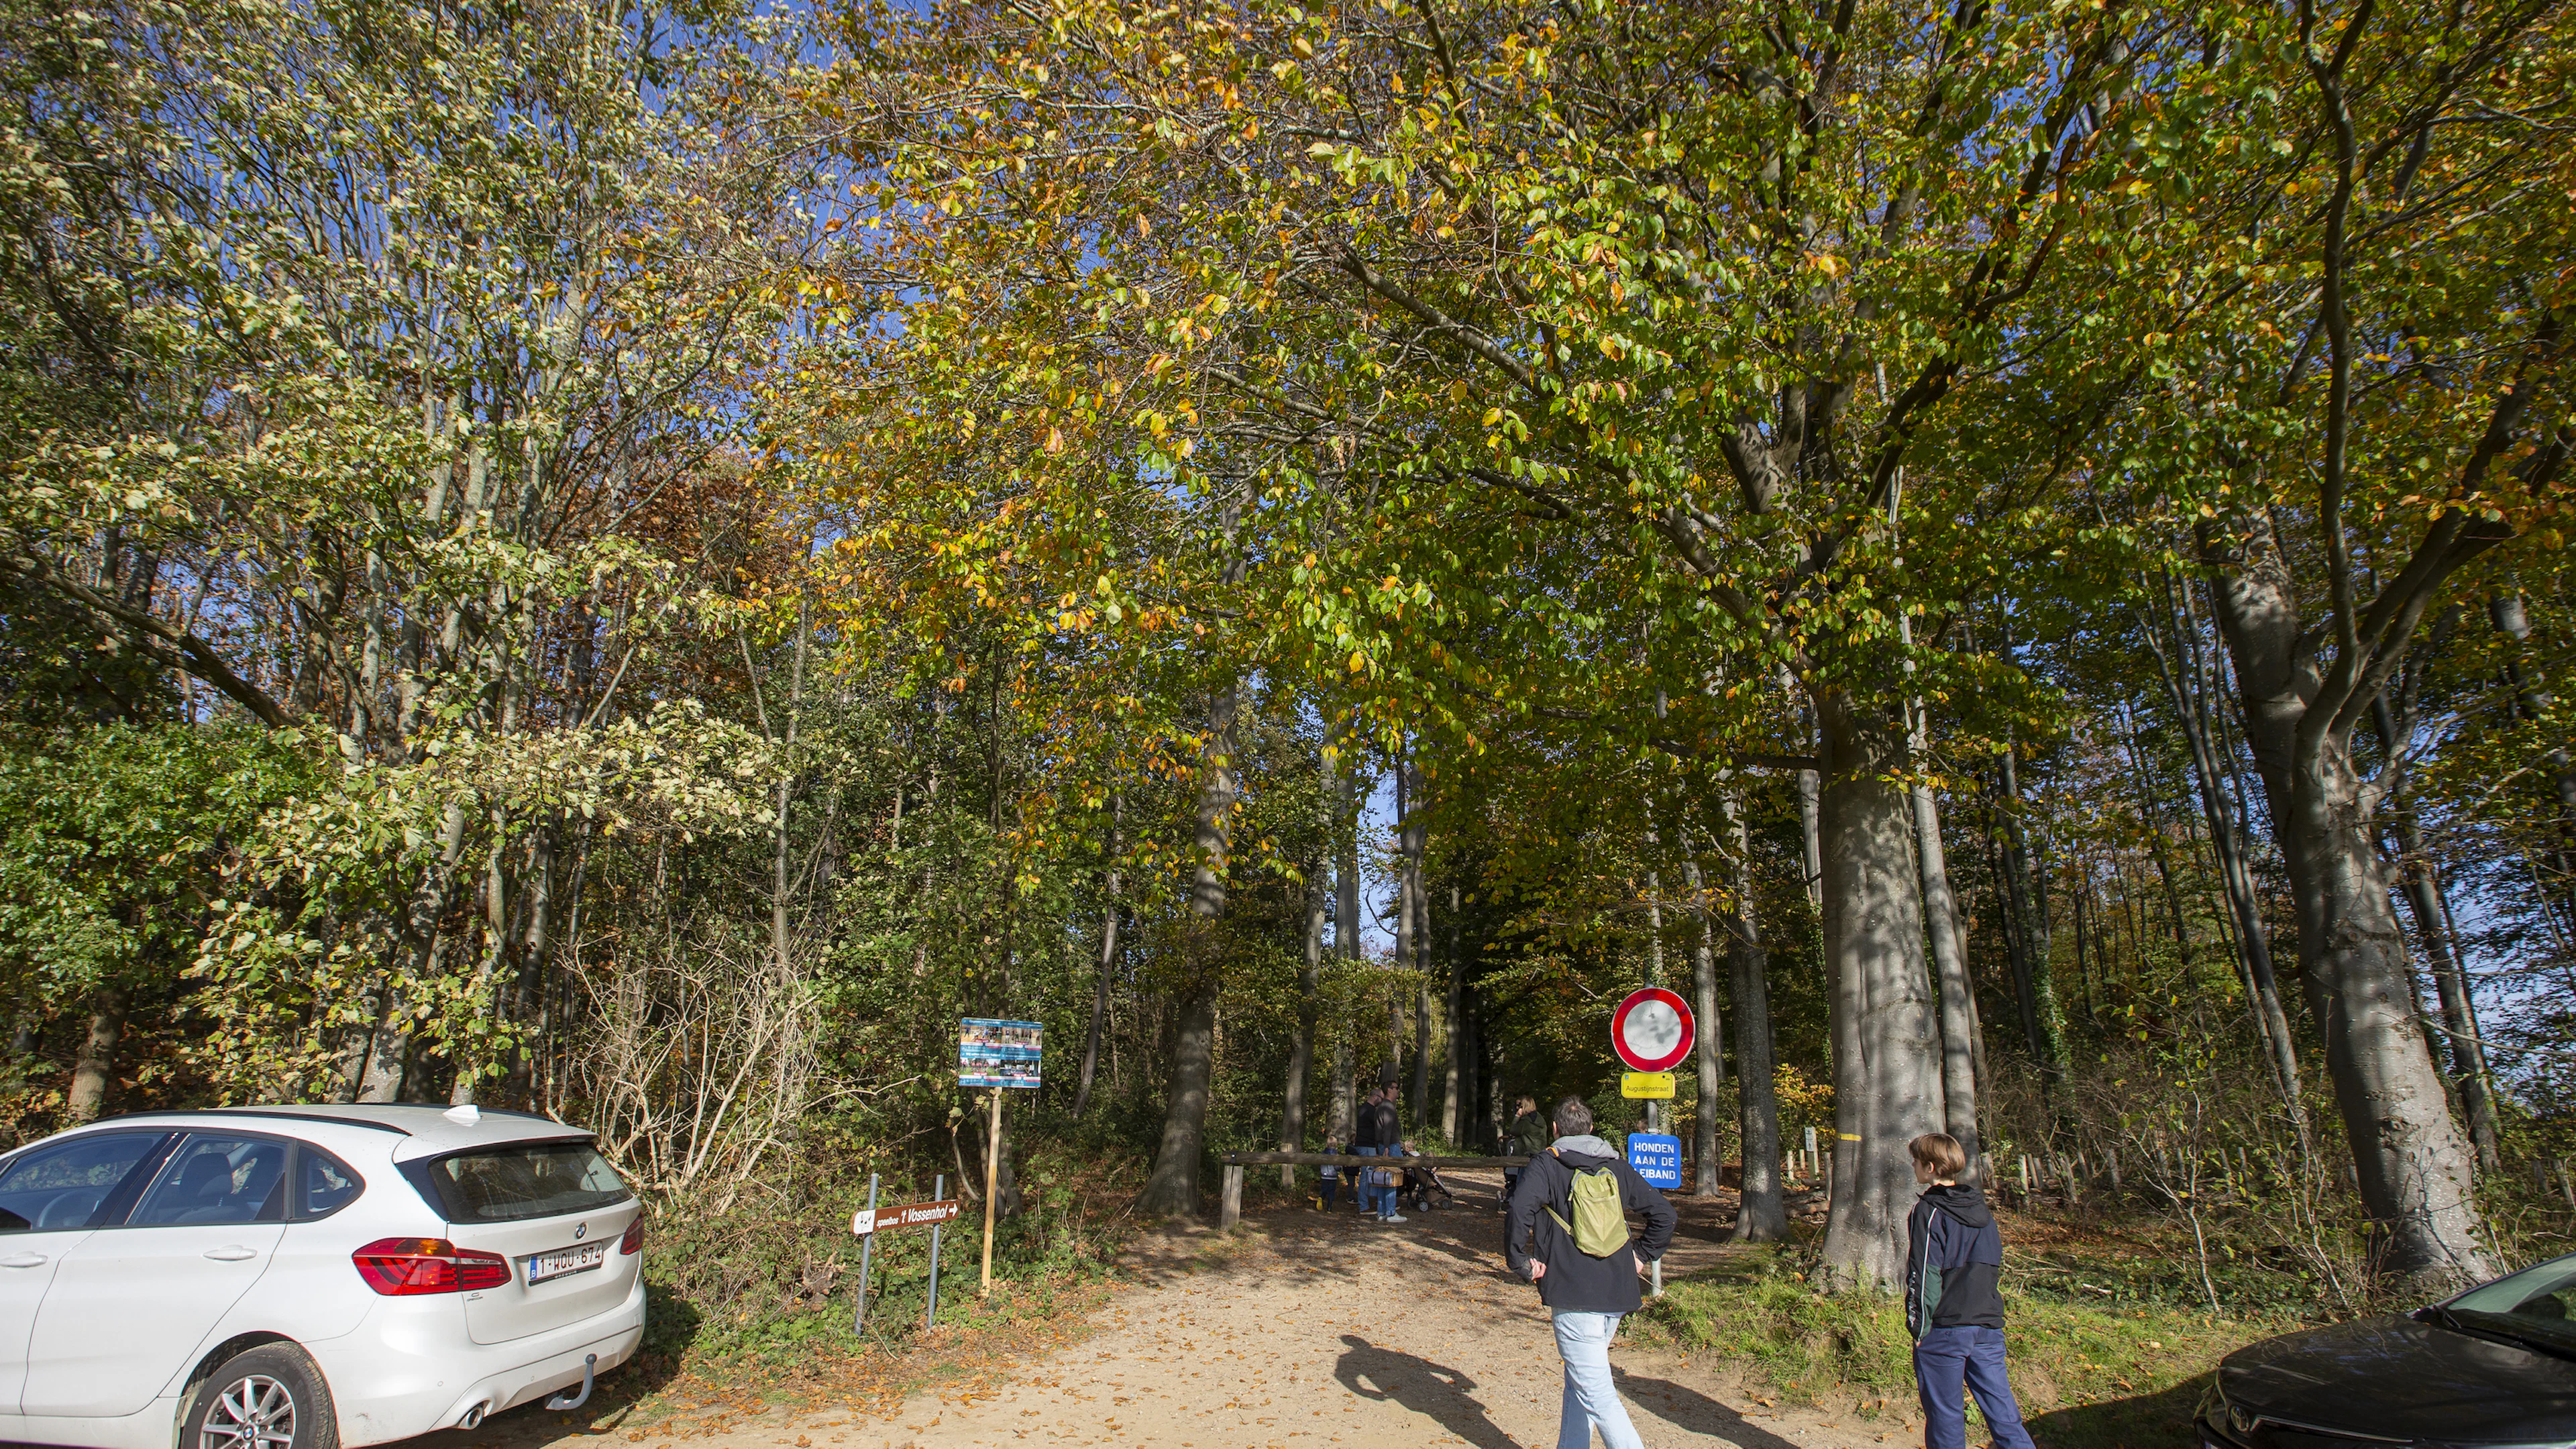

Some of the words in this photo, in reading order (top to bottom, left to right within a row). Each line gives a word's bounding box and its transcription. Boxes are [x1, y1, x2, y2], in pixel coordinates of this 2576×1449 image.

[1634, 1142, 1674, 1153] HONDEN
[1635, 1155, 1656, 1165] AAN
[1661, 1157, 1674, 1167] DE
[1634, 1168, 1676, 1180] EIBAND
[876, 1216, 899, 1228] speelbos
[908, 1204, 949, 1223] Vossenhol
